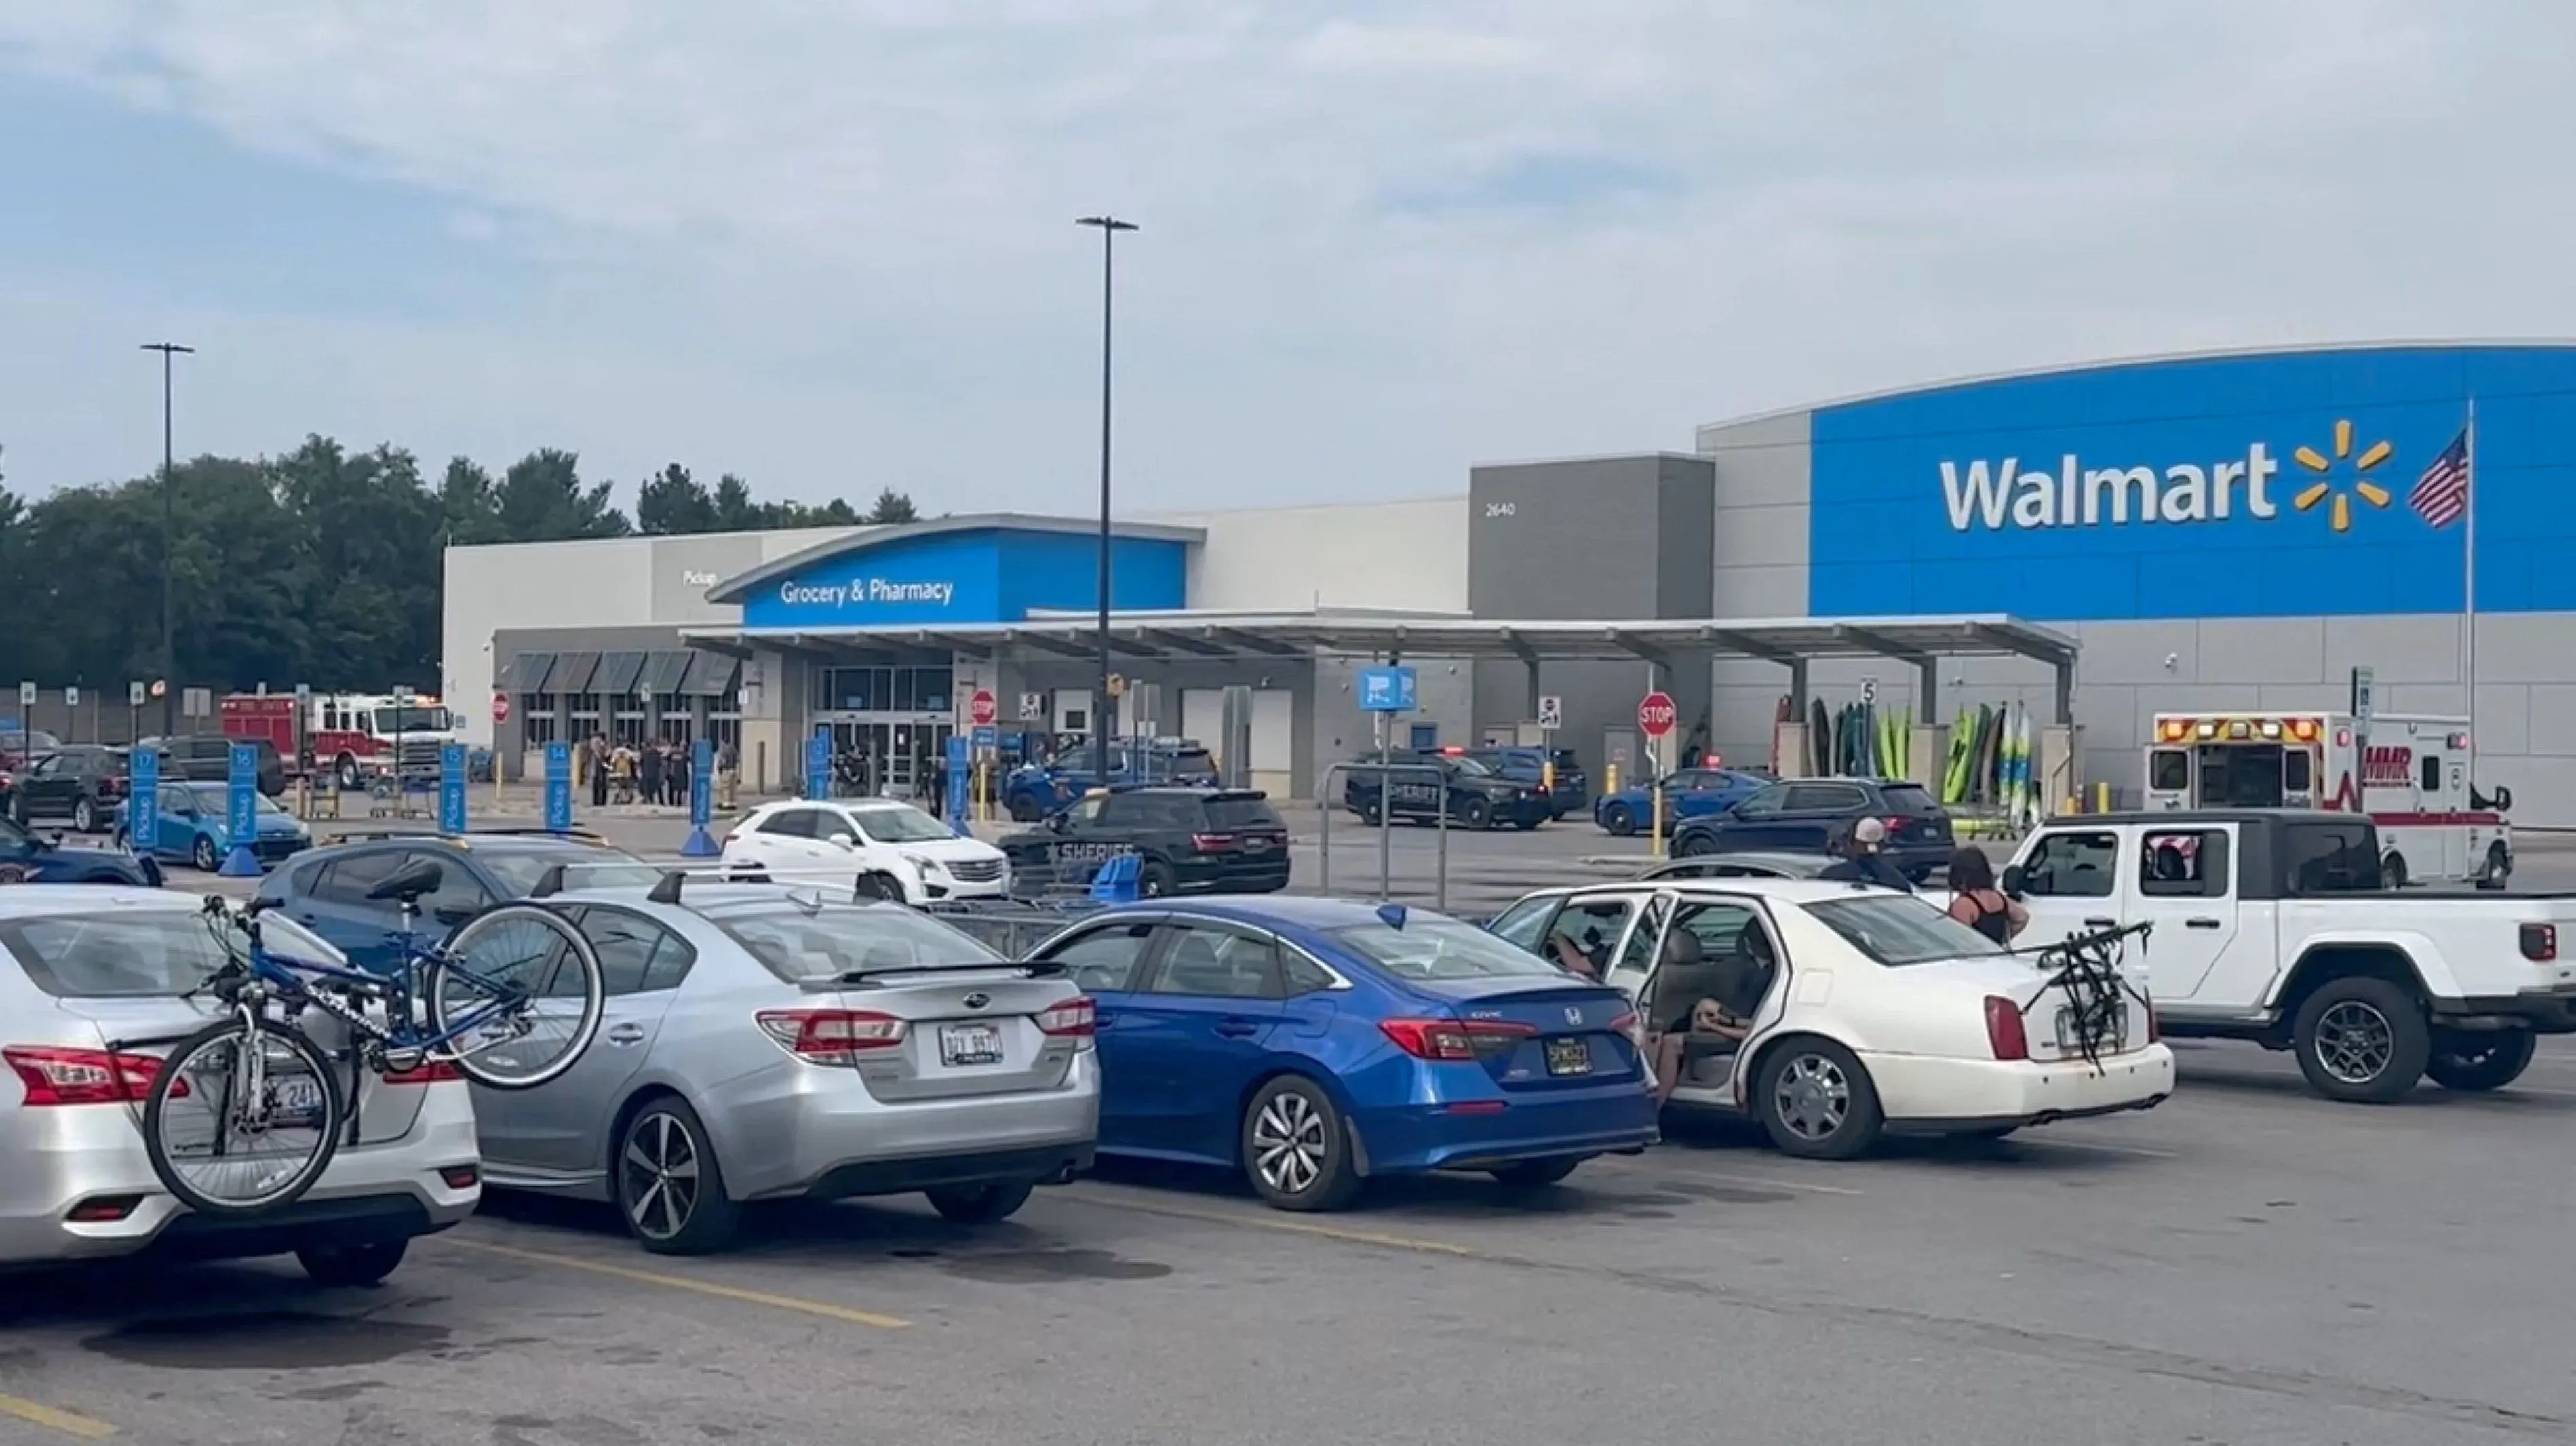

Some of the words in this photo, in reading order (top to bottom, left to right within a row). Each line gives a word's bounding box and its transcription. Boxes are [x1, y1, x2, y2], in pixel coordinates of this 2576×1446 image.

[1940, 442, 2278, 531] Walmart
[1485, 503, 1517, 517] 2640
[682, 570, 717, 589] Pickup
[781, 581, 846, 608] Grocery
[851, 579, 864, 602] &
[870, 578, 953, 606] Pharmacy
[1863, 682, 1875, 701] 5
[1642, 707, 1675, 723] STOP
[138, 753, 151, 768] 17
[237, 751, 251, 767] 16
[448, 748, 461, 762] 15
[552, 746, 566, 759] 14
[2363, 746, 2413, 779] MMR
[235, 792, 251, 836] Pickup
[445, 787, 461, 829] Pickup
[550, 784, 566, 825] Pickup
[136, 796, 153, 840] Pickup
